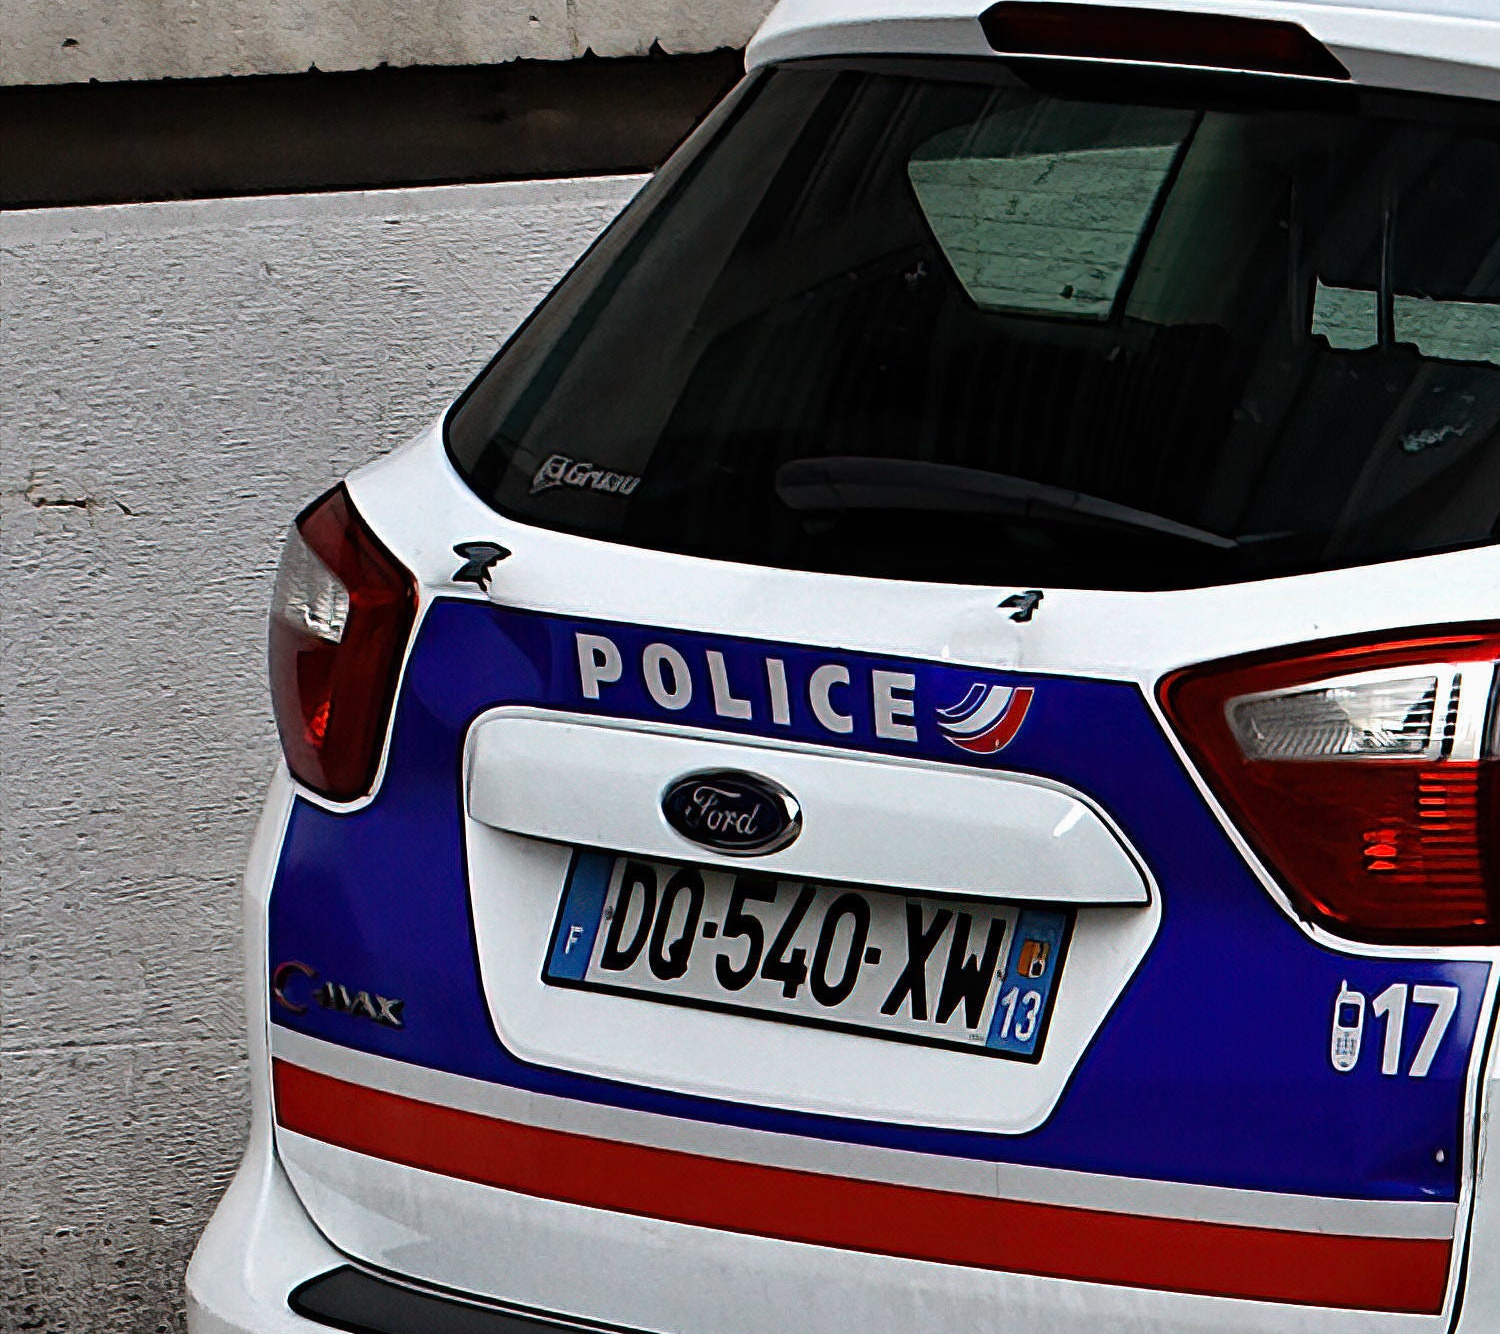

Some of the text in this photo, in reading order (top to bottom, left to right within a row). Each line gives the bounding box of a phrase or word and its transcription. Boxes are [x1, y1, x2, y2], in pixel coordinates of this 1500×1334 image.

[575, 631, 918, 743] POLICE
[685, 786, 761, 835] Ford
[564, 862, 1042, 1043] F DQ-540-XW 13
[1372, 983, 1460, 1078] 17
